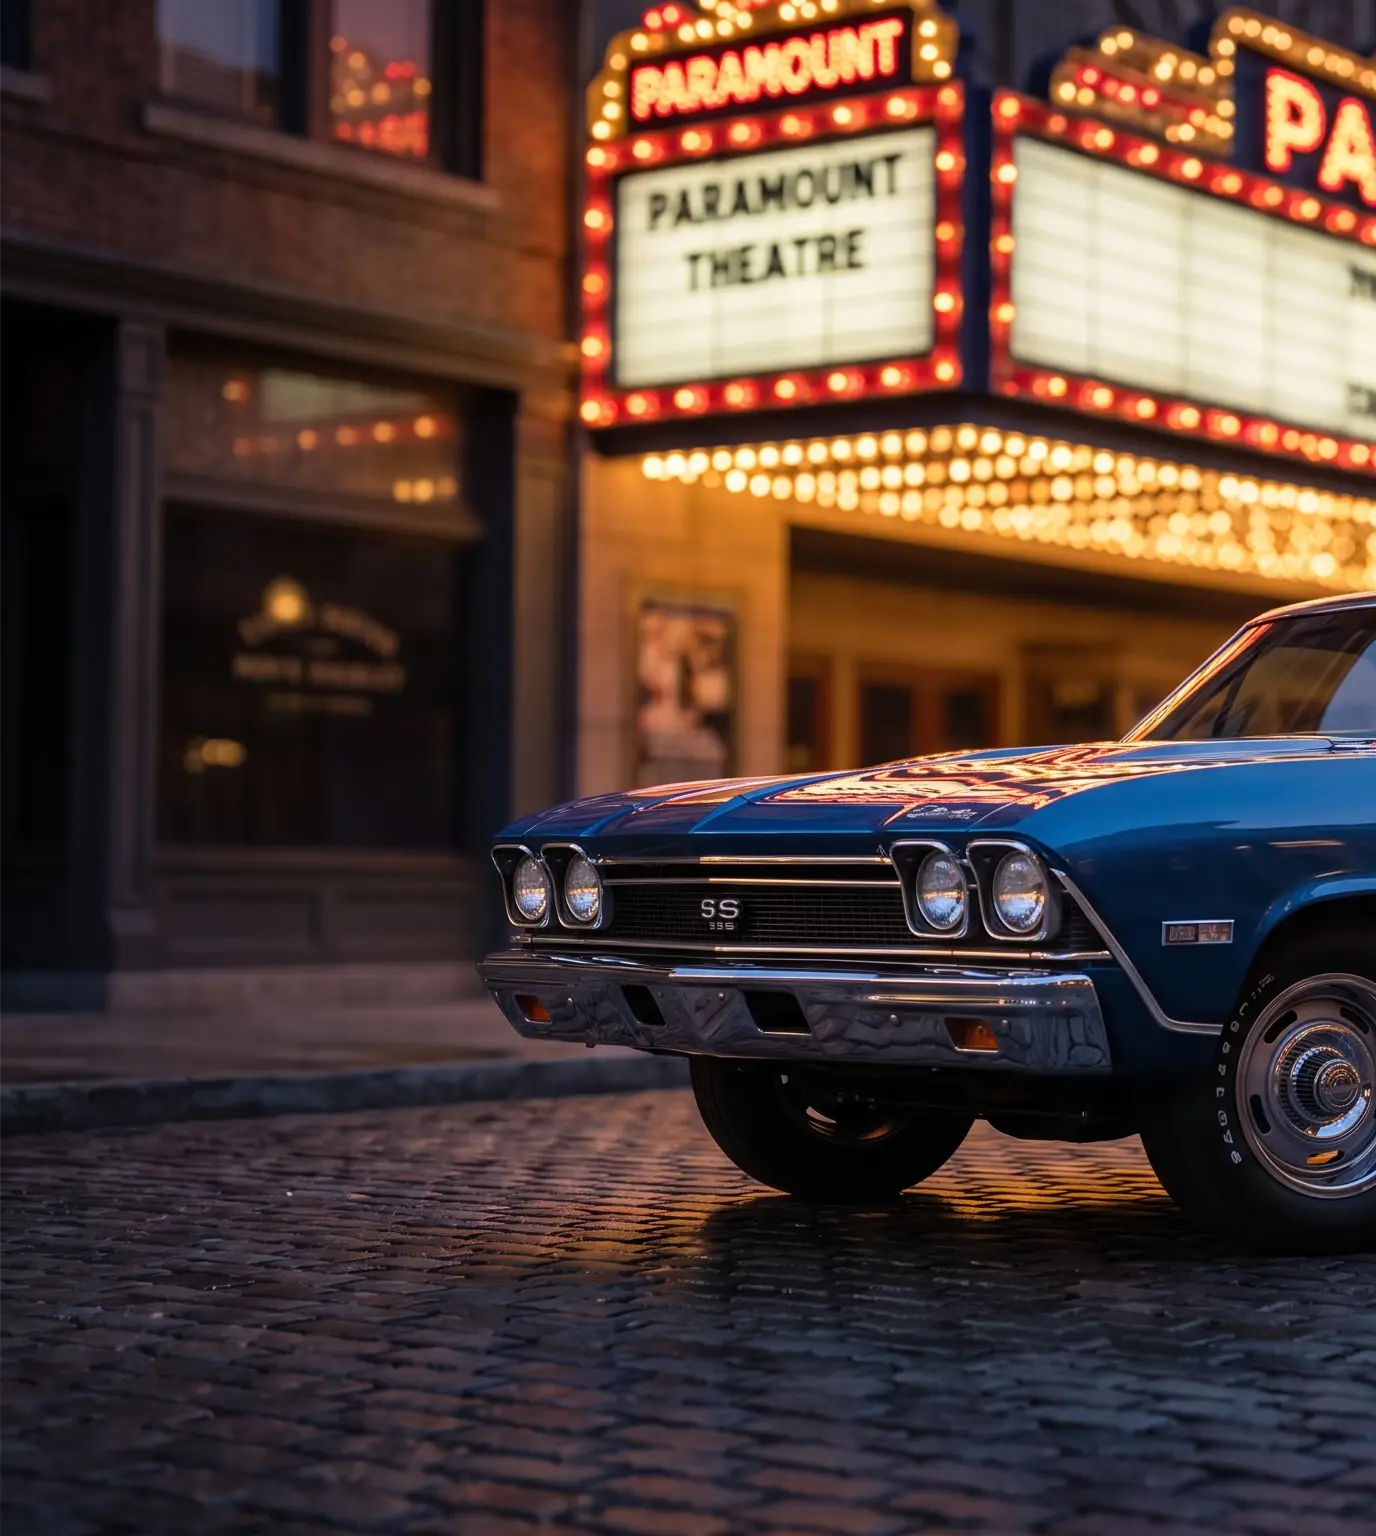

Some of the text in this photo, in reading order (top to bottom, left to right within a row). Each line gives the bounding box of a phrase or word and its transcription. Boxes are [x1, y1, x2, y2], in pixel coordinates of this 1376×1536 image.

[631, 18, 904, 121] PARAMOUNT
[647, 152, 903, 231] PARAMOUNT
[685, 229, 865, 292] THEATRE
[701, 899, 739, 918] SS
